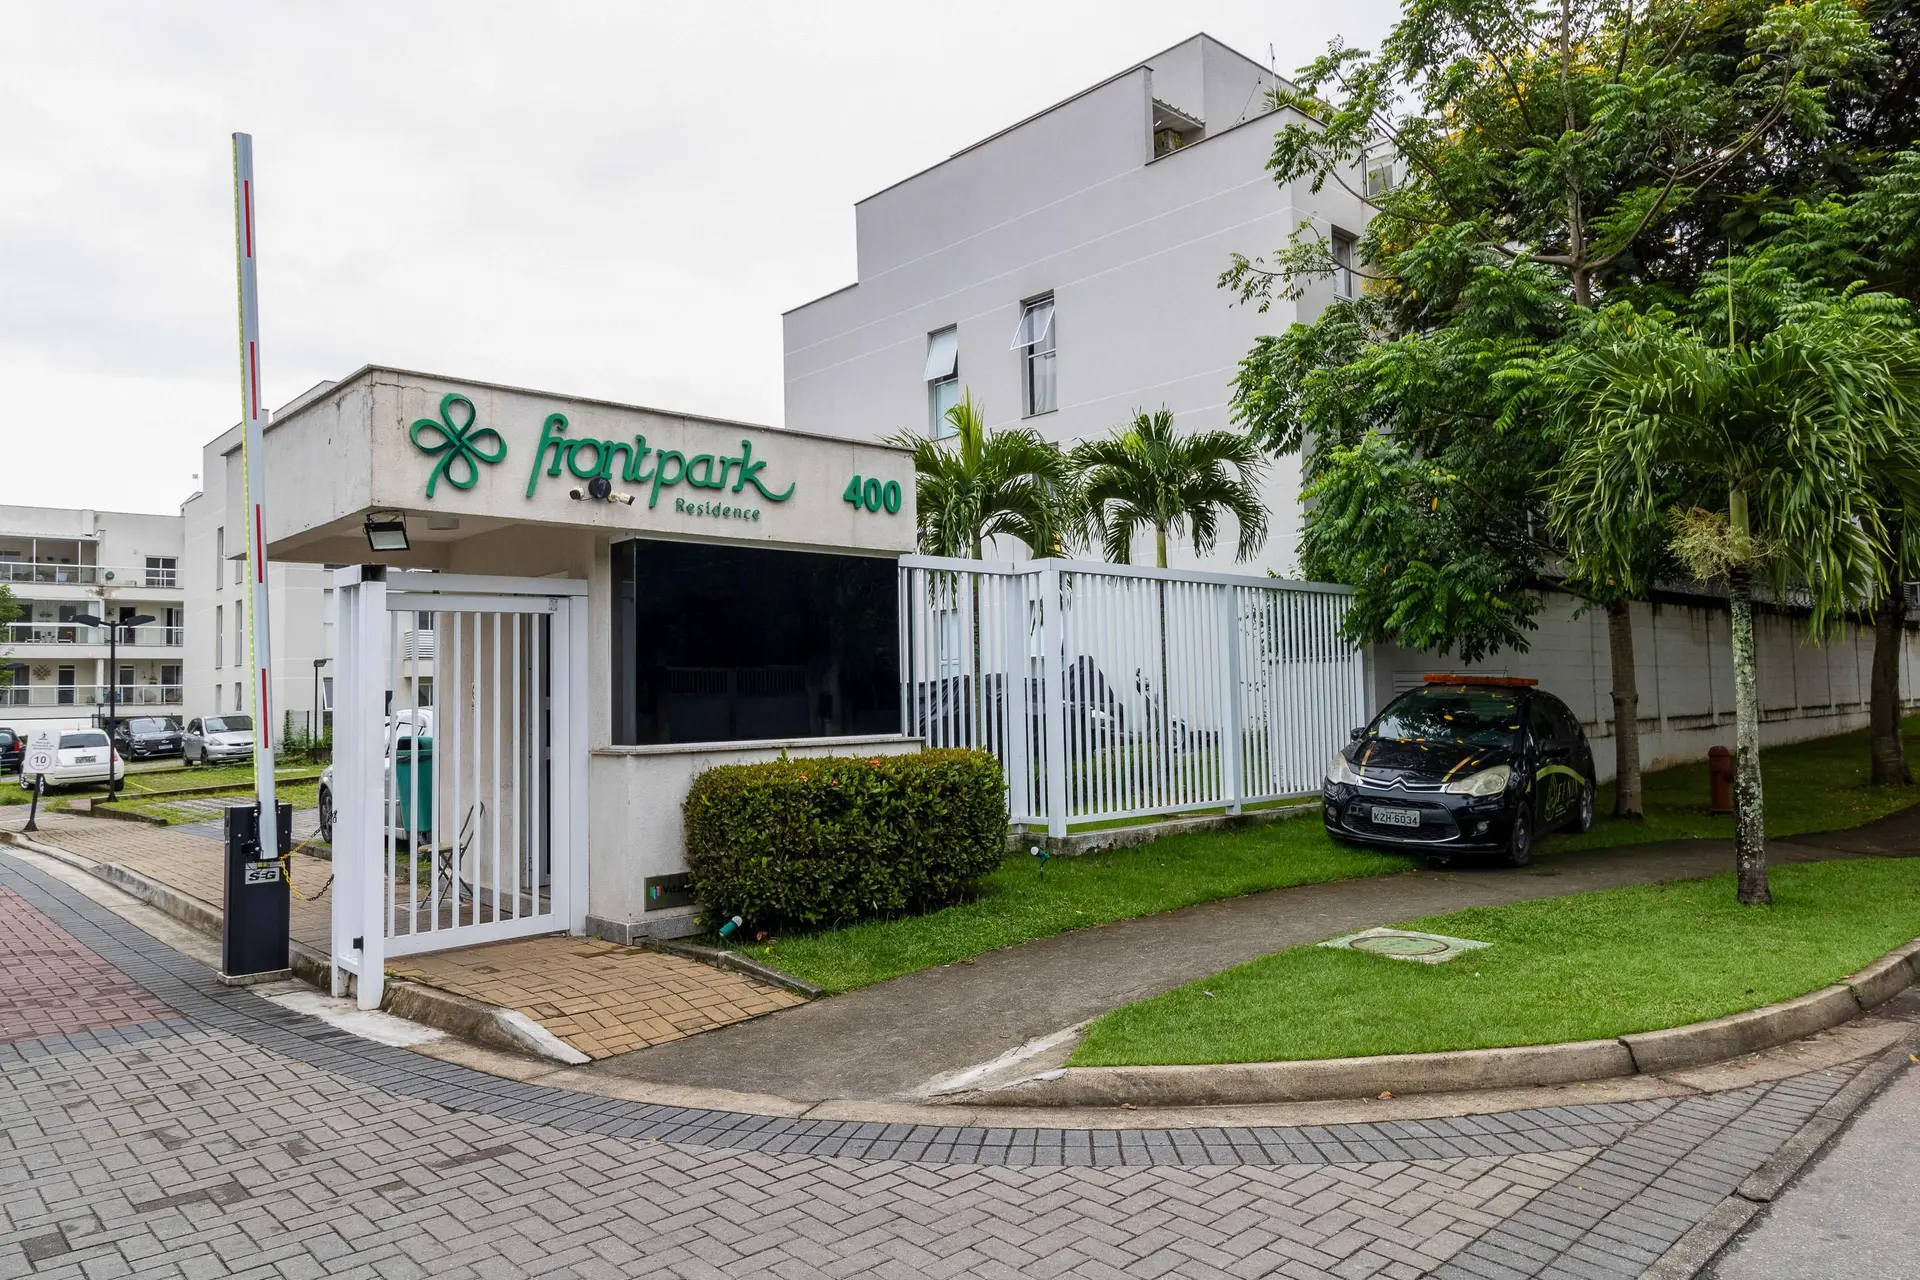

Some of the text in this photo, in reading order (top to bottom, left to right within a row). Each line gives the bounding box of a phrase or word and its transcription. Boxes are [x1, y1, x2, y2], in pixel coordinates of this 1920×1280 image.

[526, 412, 795, 509] frontpark
[843, 475, 902, 514] 400
[675, 497, 761, 521] Residence
[34, 755, 47, 764] 10
[248, 871, 276, 881] SEG
